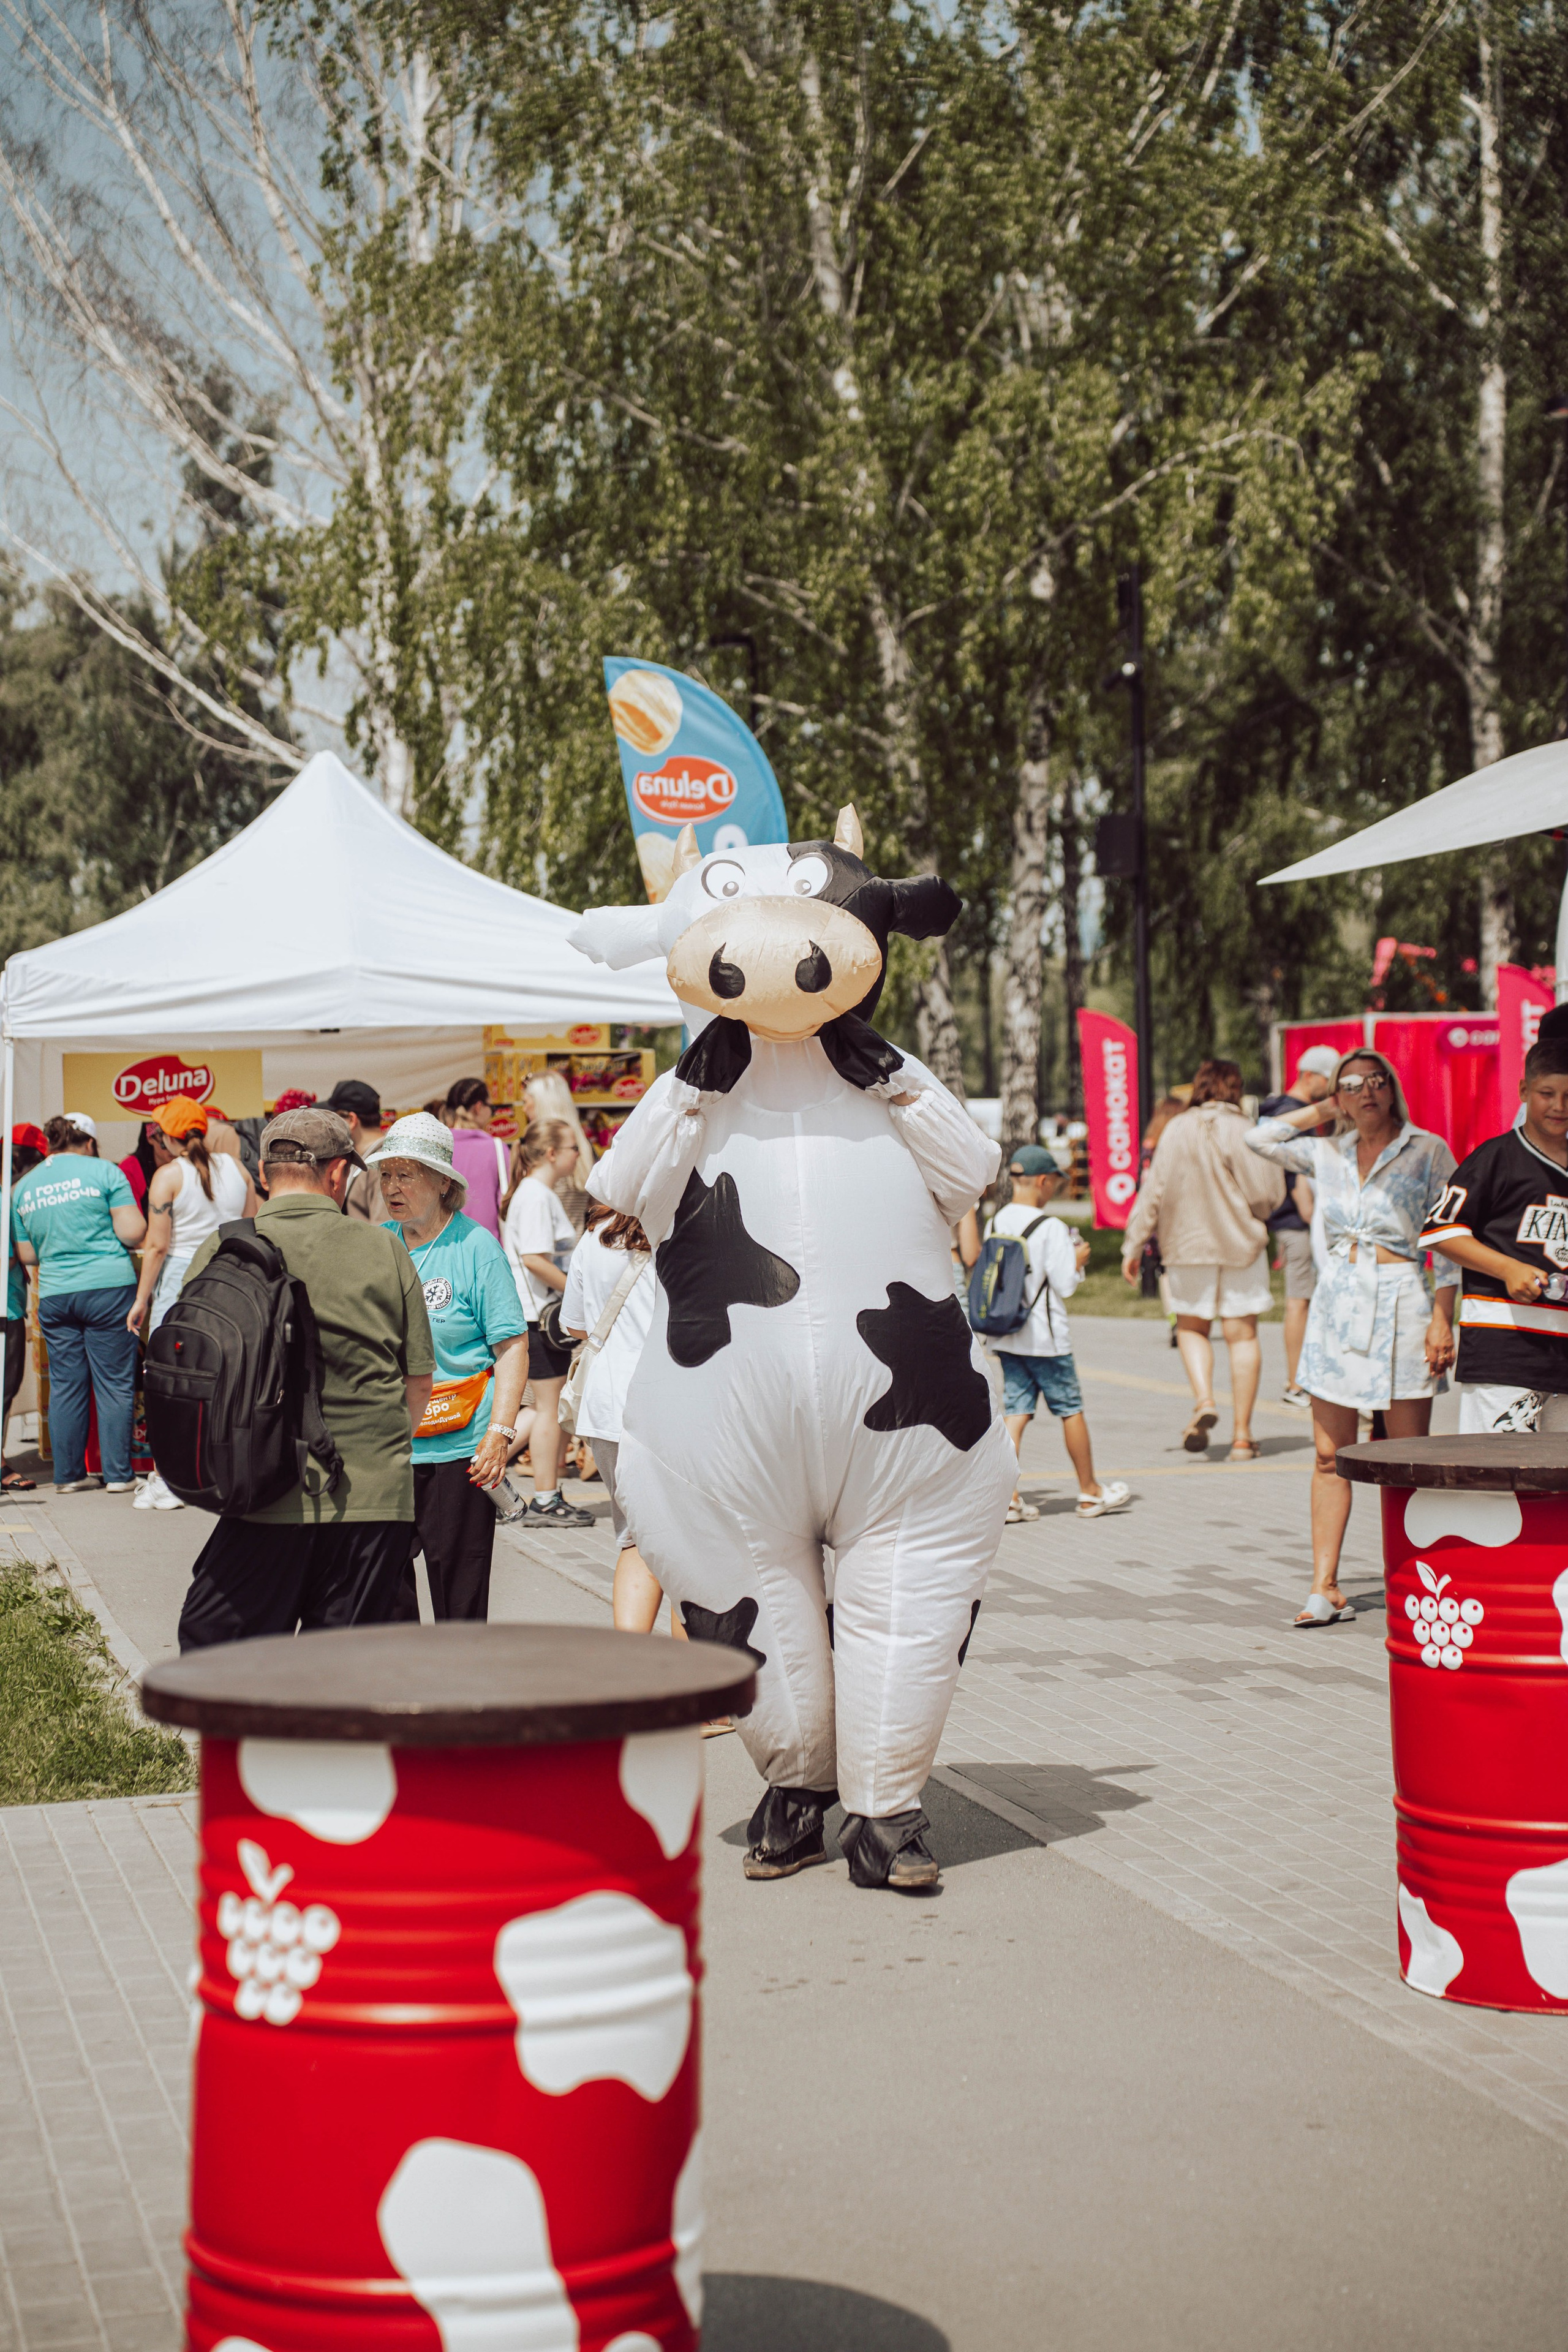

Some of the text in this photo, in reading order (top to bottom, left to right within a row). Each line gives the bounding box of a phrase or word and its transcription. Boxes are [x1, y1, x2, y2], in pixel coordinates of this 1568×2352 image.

[119, 1068, 207, 1102] Deluna
[23, 1178, 81, 1202] Я ГОТОВ
[37, 1186, 100, 1209] ПОМОЧЬ
[419, 1412, 461, 1427] олодыДушой
[425, 1403, 450, 1417] бро
